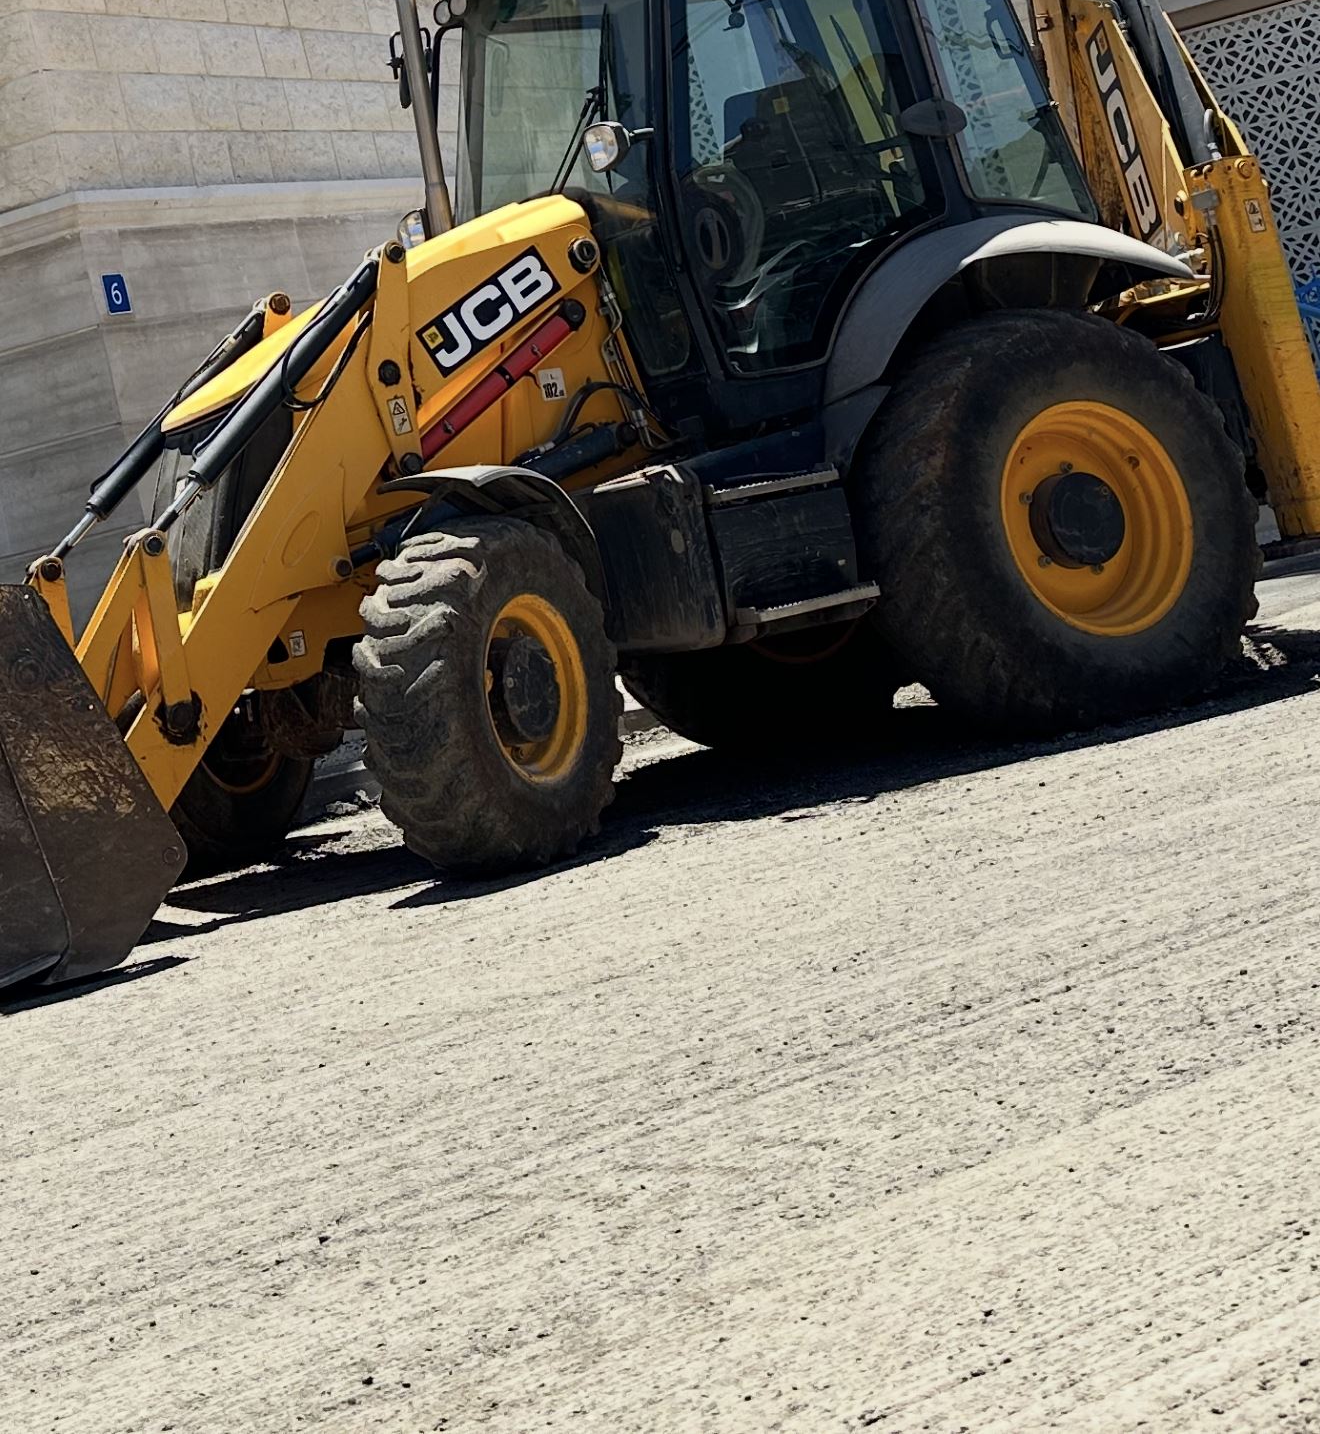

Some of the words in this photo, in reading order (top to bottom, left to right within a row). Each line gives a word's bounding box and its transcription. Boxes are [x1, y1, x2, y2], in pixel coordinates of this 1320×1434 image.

[1090, 40, 1157, 234] JCB
[111, 282, 122, 305] 6
[435, 255, 553, 368] JCB
